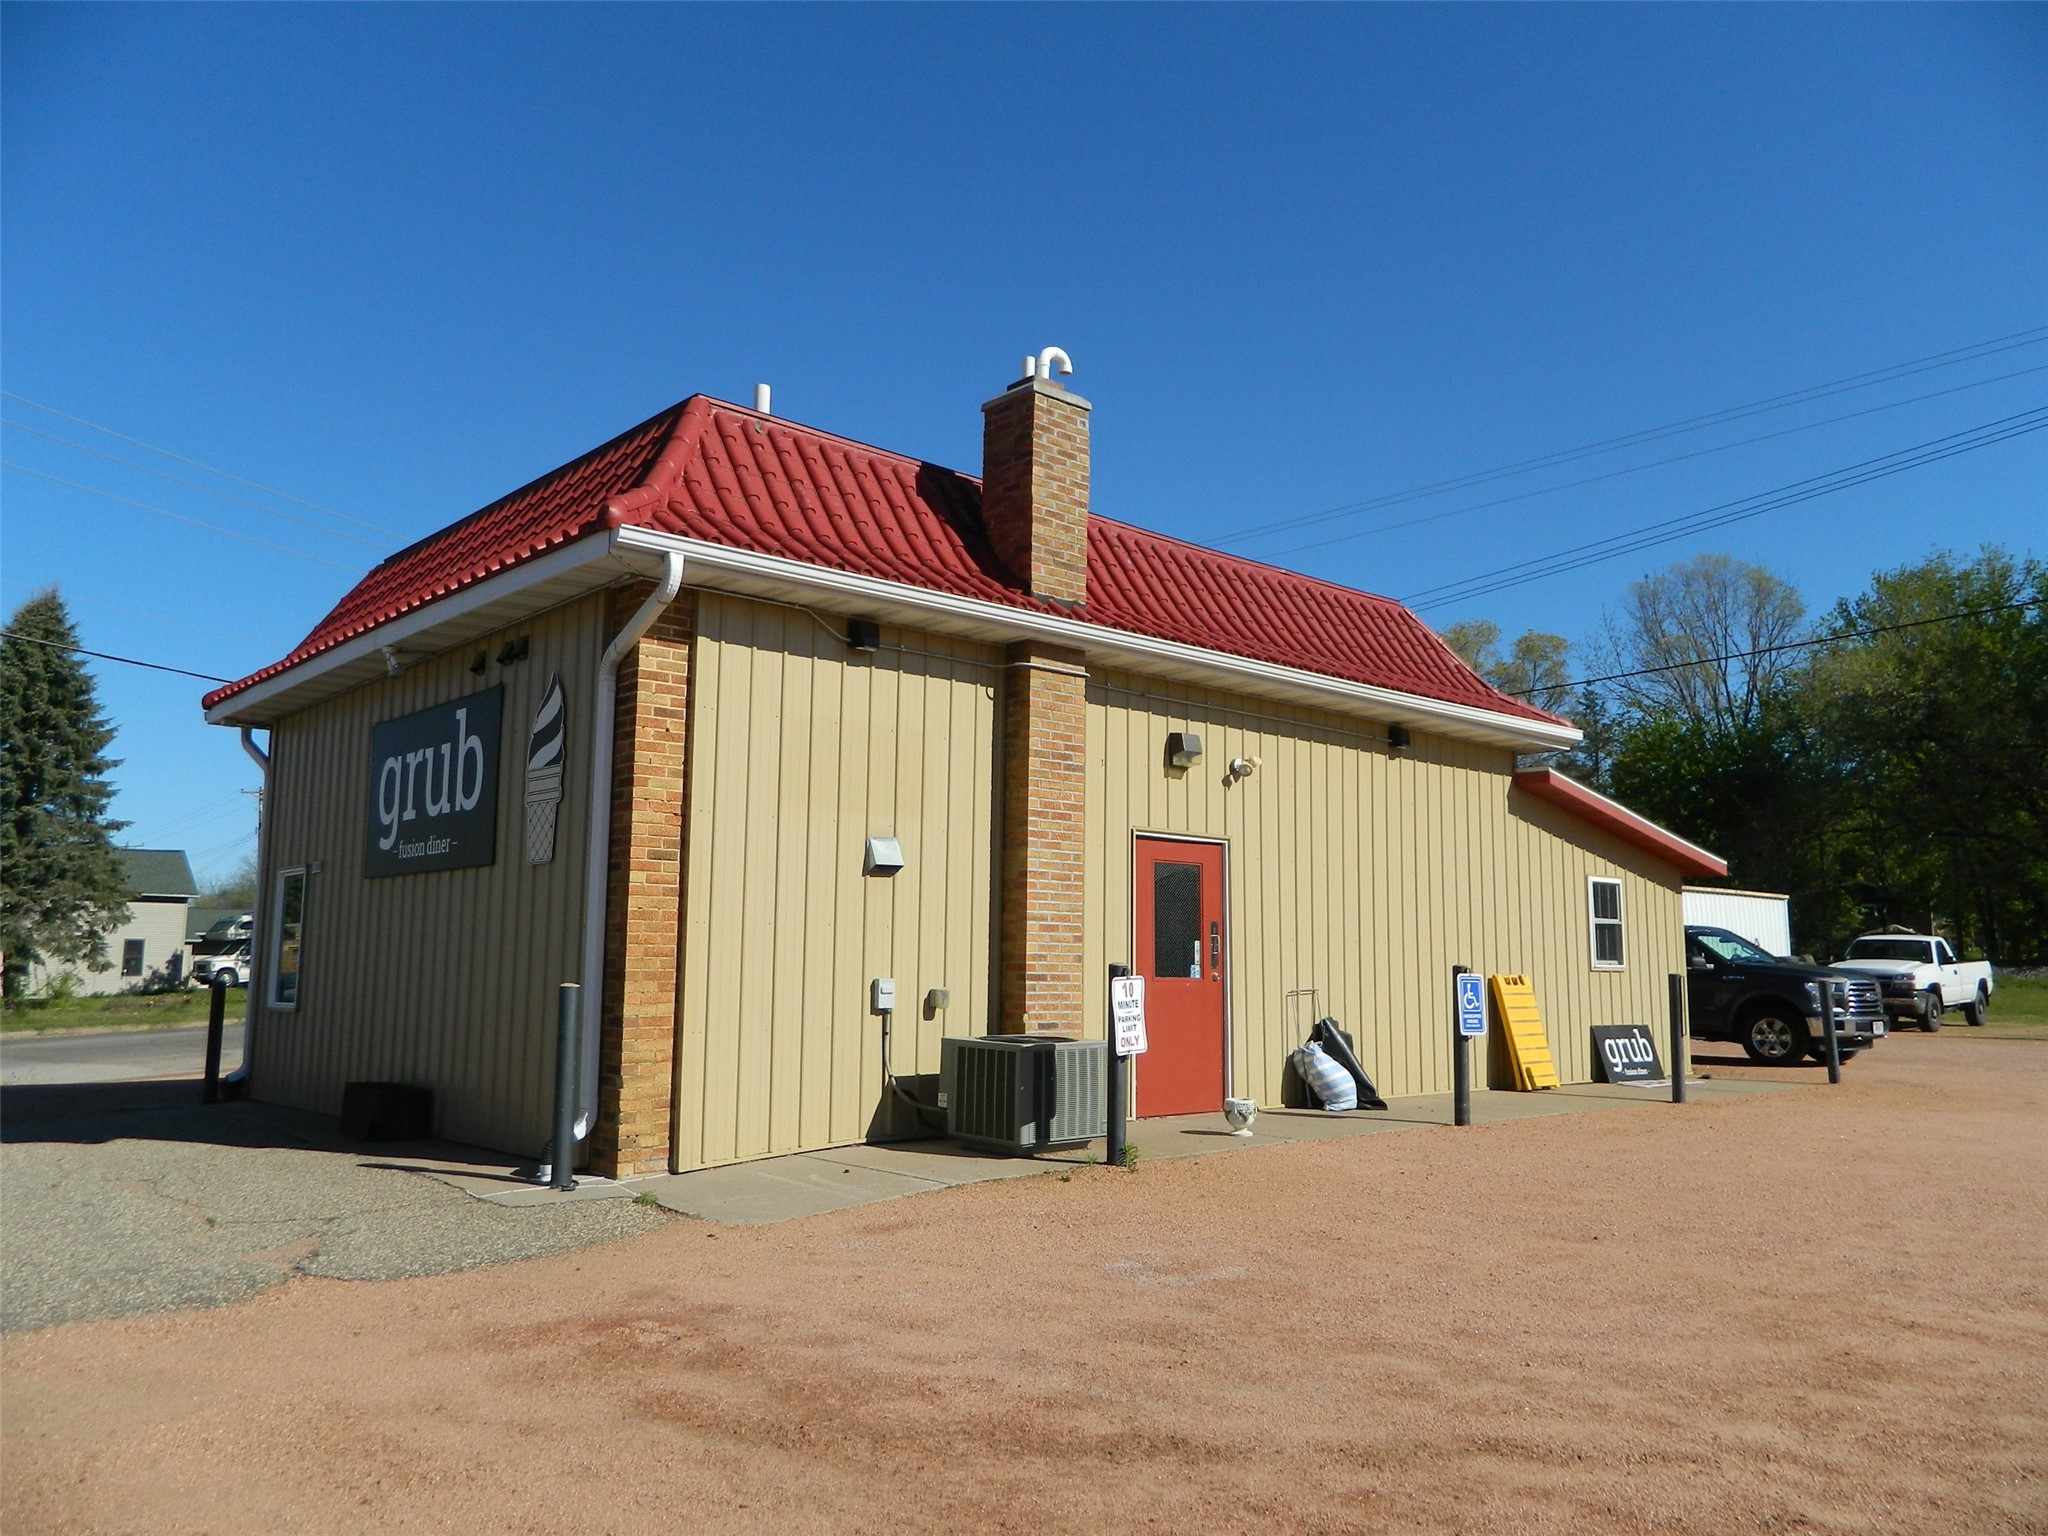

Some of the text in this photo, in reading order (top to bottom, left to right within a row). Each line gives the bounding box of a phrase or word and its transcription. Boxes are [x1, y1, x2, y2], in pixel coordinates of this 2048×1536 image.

[379, 707, 484, 850] grub
[398, 835, 451, 858] fusion diner
[1121, 982, 1134, 998] 10
[1117, 999, 1139, 1010] MINUTE
[1118, 1014, 1141, 1023] PARKING
[1122, 1024, 1137, 1033] LIMIT
[1120, 1035, 1140, 1048] ONLY
[1604, 1028, 1653, 1073] grub
